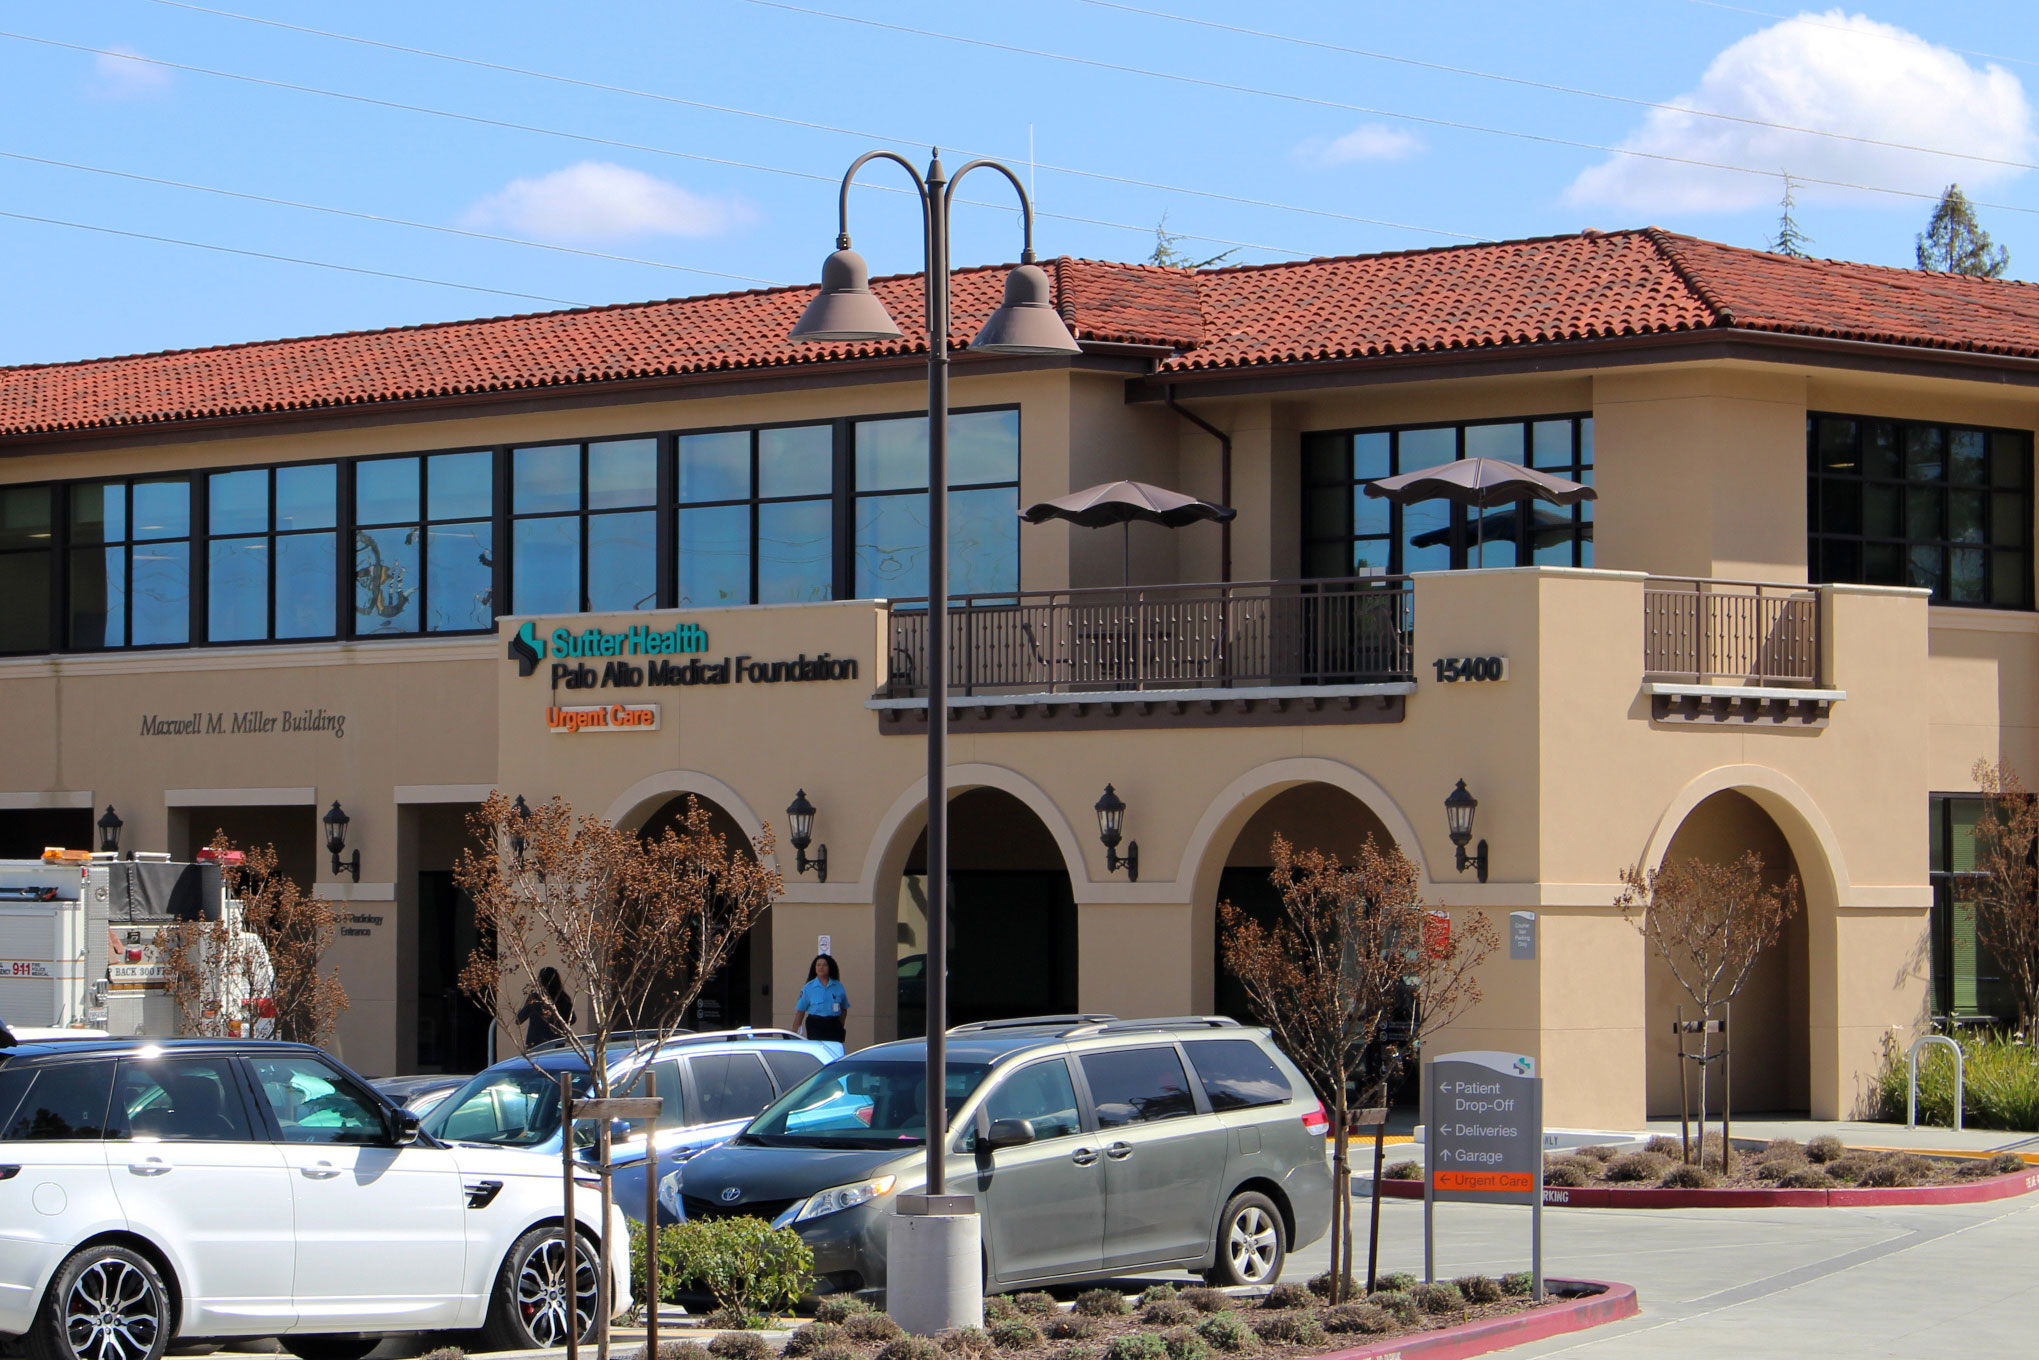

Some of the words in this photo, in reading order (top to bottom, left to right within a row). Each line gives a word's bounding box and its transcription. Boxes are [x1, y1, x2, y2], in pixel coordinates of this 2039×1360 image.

[551, 628, 627, 659] Sutter
[629, 623, 708, 655] Health
[551, 660, 598, 690] Palo
[600, 660, 643, 688] Alto
[648, 656, 730, 687] Medical
[735, 653, 858, 684] Foundation
[1432, 656, 1504, 682] 15400
[140, 713, 202, 736] Maxwell
[205, 712, 226, 734] M.
[231, 711, 278, 734] Miller
[281, 709, 346, 738] Building
[546, 706, 607, 733] Urgent
[610, 704, 654, 727] Care
[115, 967, 137, 977] BACK
[140, 967, 155, 976] 300
[1455, 1081, 1501, 1095] Patient
[1455, 1098, 1515, 1114] Drop-Off
[1455, 1124, 1518, 1137] Deliveries
[1543, 1135, 1559, 1146] NLY
[1455, 1149, 1503, 1165] Garage
[1455, 1174, 1496, 1188] Urgent
[1499, 1174, 1529, 1188] Care
[1543, 1190, 1569, 1203] RKING
